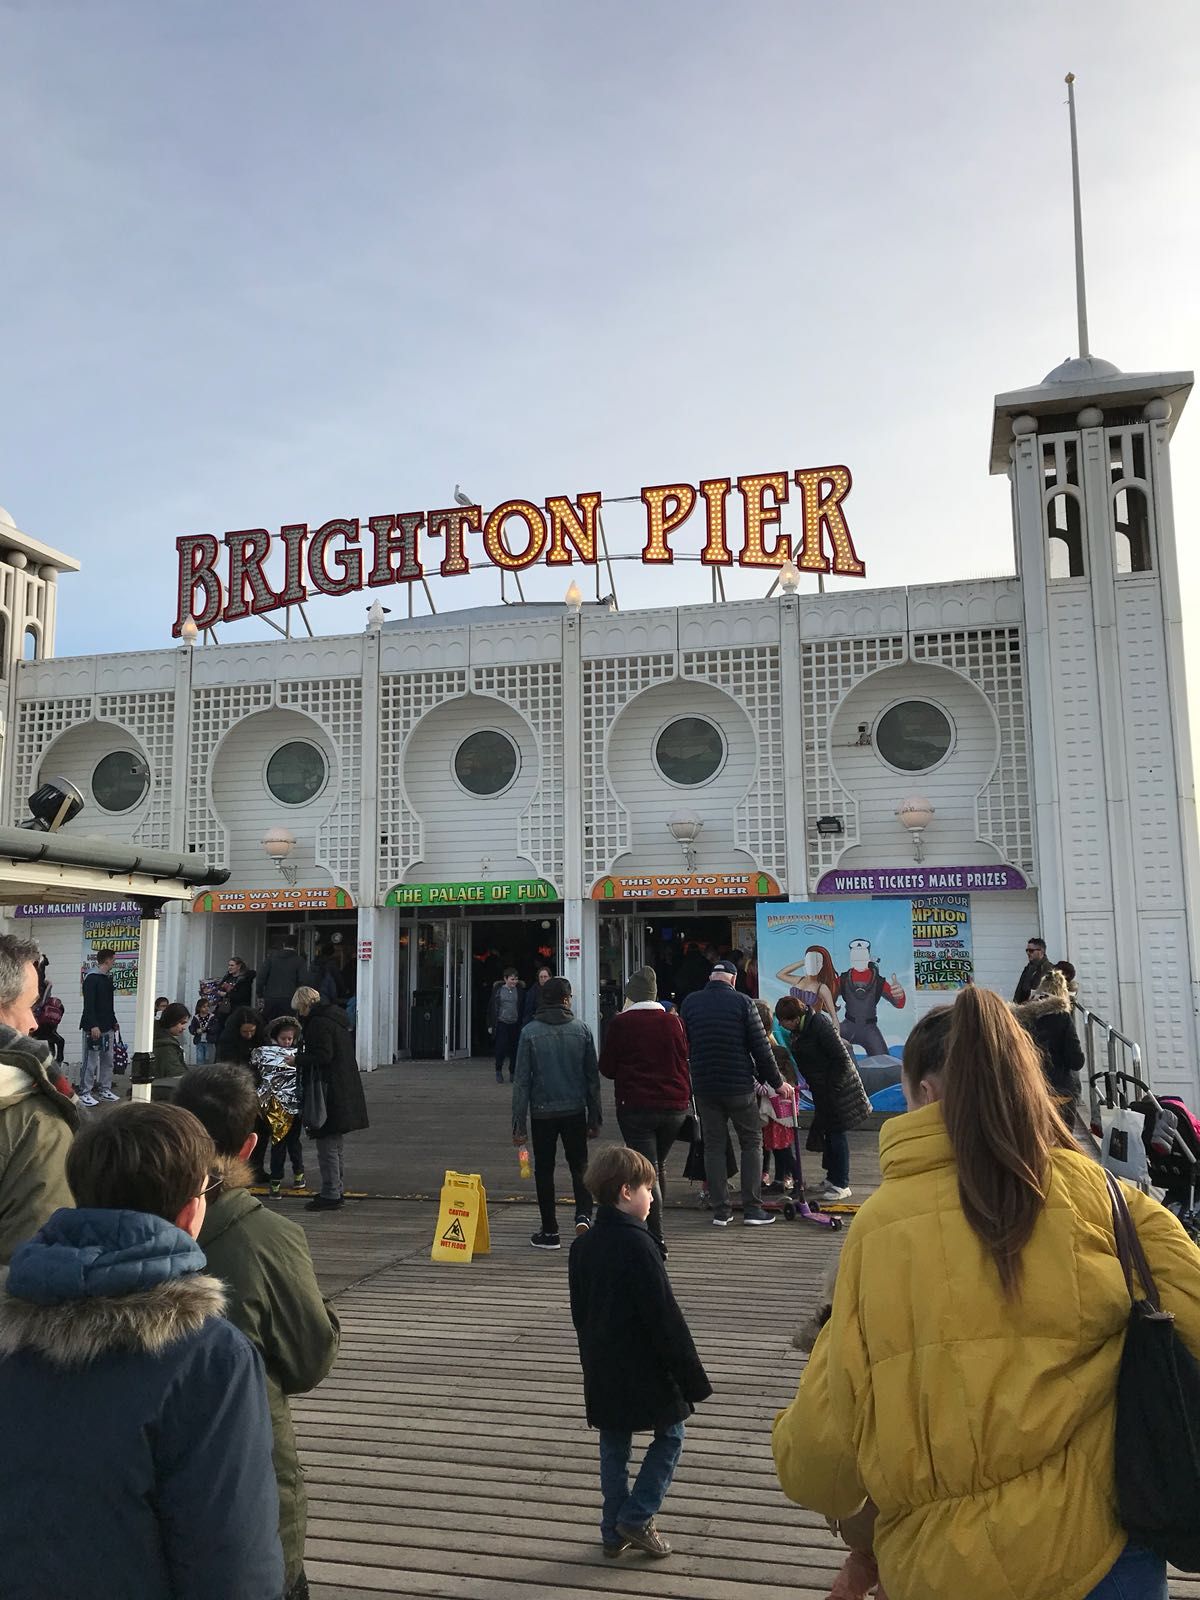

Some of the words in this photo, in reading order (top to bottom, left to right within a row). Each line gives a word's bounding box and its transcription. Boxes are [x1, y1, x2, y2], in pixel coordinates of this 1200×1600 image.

[171, 491, 602, 638] BRIGHTON
[641, 464, 867, 577] PIER
[619, 878, 651, 886] THIS
[656, 877, 691, 885] WAY
[696, 876, 717, 884] TO
[835, 876, 875, 890] WHERE
[879, 874, 925, 889] TICKETS
[929, 873, 963, 887] MAKE
[967, 872, 1008, 886] PRIZES
[250, 891, 280, 899] WAY
[284, 890, 302, 898] TO
[305, 889, 330, 897] THE
[394, 889, 422, 903] THE
[429, 886, 485, 902] PALACE
[491, 884, 511, 900] OF
[518, 883, 549, 899] FUN
[657, 888, 678, 896] OF
[681, 888, 709, 896] THE
[714, 886, 748, 895] PIER
[23, 904, 44, 915] CASH
[47, 903, 86, 914] MACHINE
[88, 902, 117, 912] INSIDE
[120, 901, 142, 912] ARC
[219, 903, 246, 911] END
[250, 902, 269, 910] OF
[271, 901, 295, 909] THE
[298, 900, 328, 908] PIER
[912, 899, 925, 908] ND
[927, 896, 945, 905] TRY
[947, 896, 969, 907] OUR
[912, 908, 967, 923] MPTION
[86, 920, 105, 928] COME
[105, 918, 121, 928] AND
[123, 916, 136, 925] TRY
[85, 926, 141, 939] REDEMPTIO
[912, 924, 958, 939] CHINES
[921, 960, 972, 972] TICKETS
